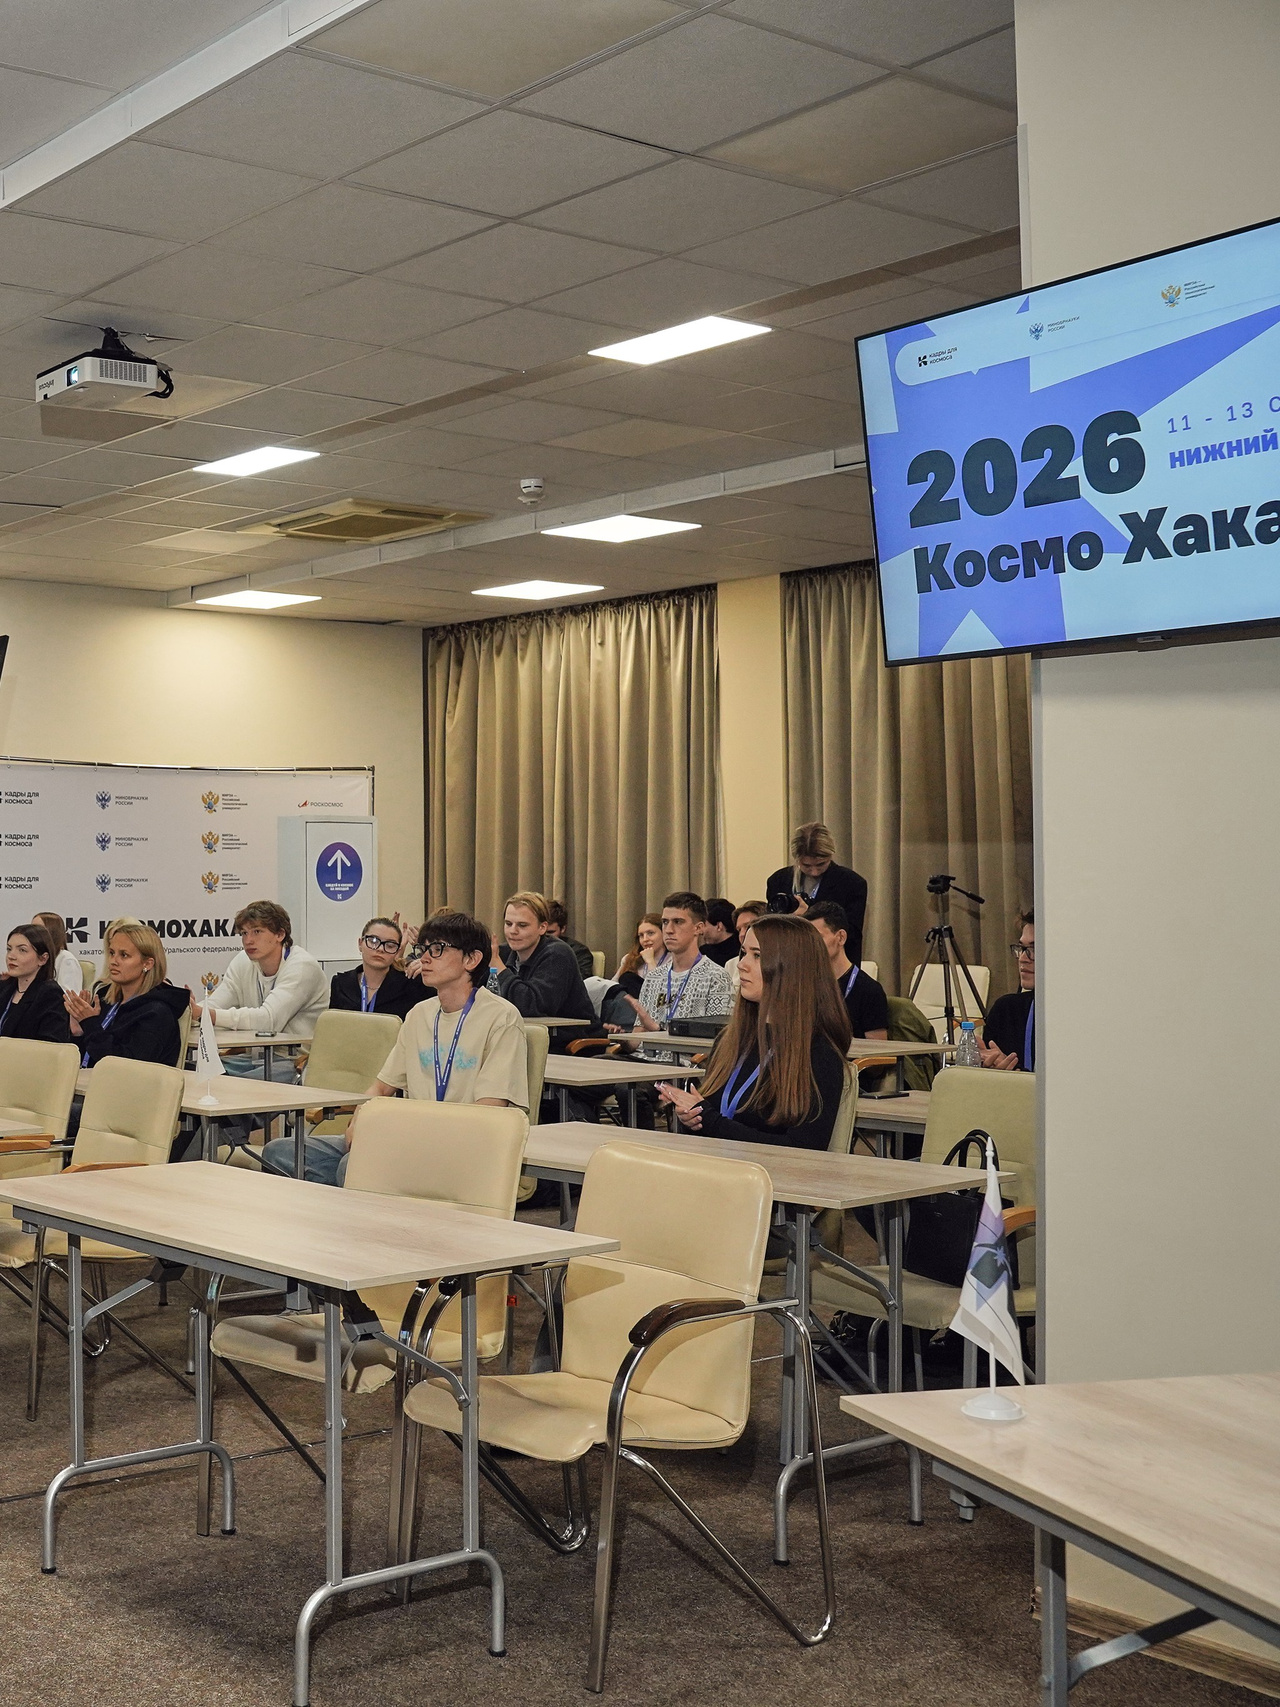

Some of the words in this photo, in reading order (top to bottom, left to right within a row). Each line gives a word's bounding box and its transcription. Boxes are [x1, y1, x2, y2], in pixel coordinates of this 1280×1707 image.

[1167, 414, 1192, 434] 11
[1226, 402, 1253, 422] 13
[907, 410, 1146, 529] 2026
[913, 530, 1104, 594] Космо
[4, 791, 26, 800] кадры
[4, 833, 26, 842] кадры
[26, 833, 40, 841] для
[4, 876, 26, 884] кадры
